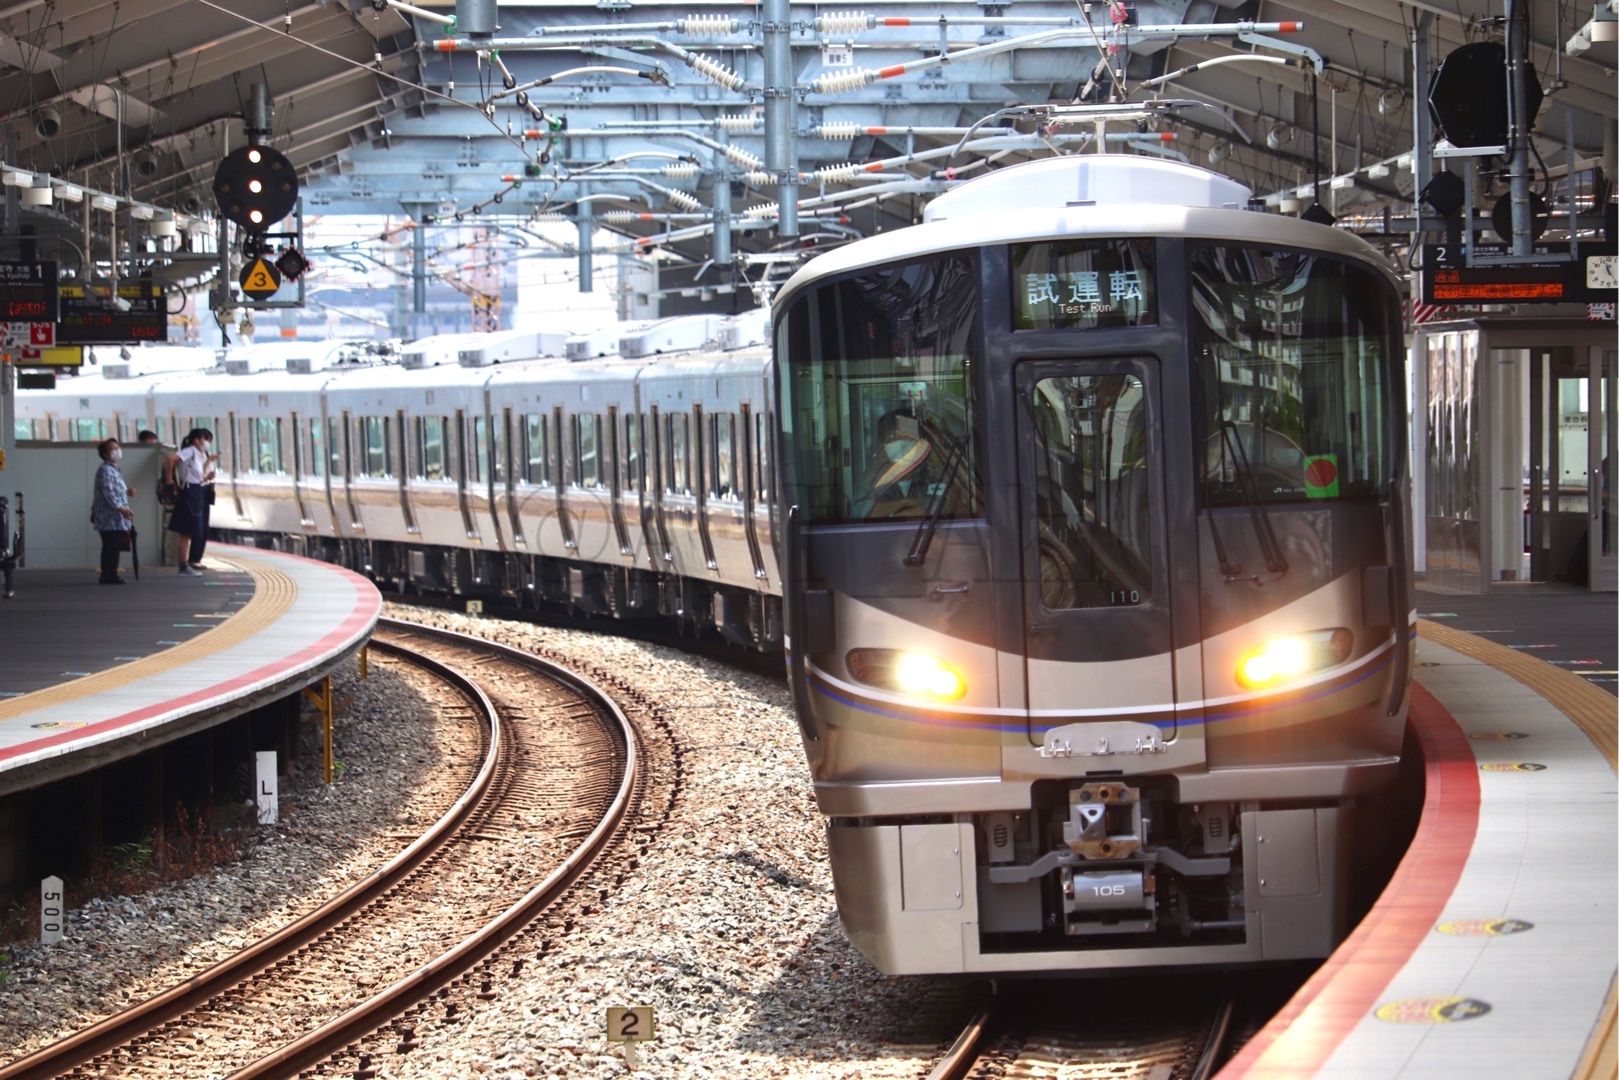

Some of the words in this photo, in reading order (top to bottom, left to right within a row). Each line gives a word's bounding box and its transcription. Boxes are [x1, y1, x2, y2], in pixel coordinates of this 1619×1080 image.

[1436, 247, 1447, 261] 2
[36, 264, 42, 278] 1
[254, 272, 267, 287] 3
[1026, 271, 1142, 304] 試運転
[1058, 303, 1086, 314] Test
[1090, 302, 1112, 313] Run
[1111, 590, 1140, 604] 110
[261, 780, 273, 795] L
[1091, 884, 1125, 897] 105
[44, 892, 60, 932] 500
[620, 1012, 639, 1036] 2
